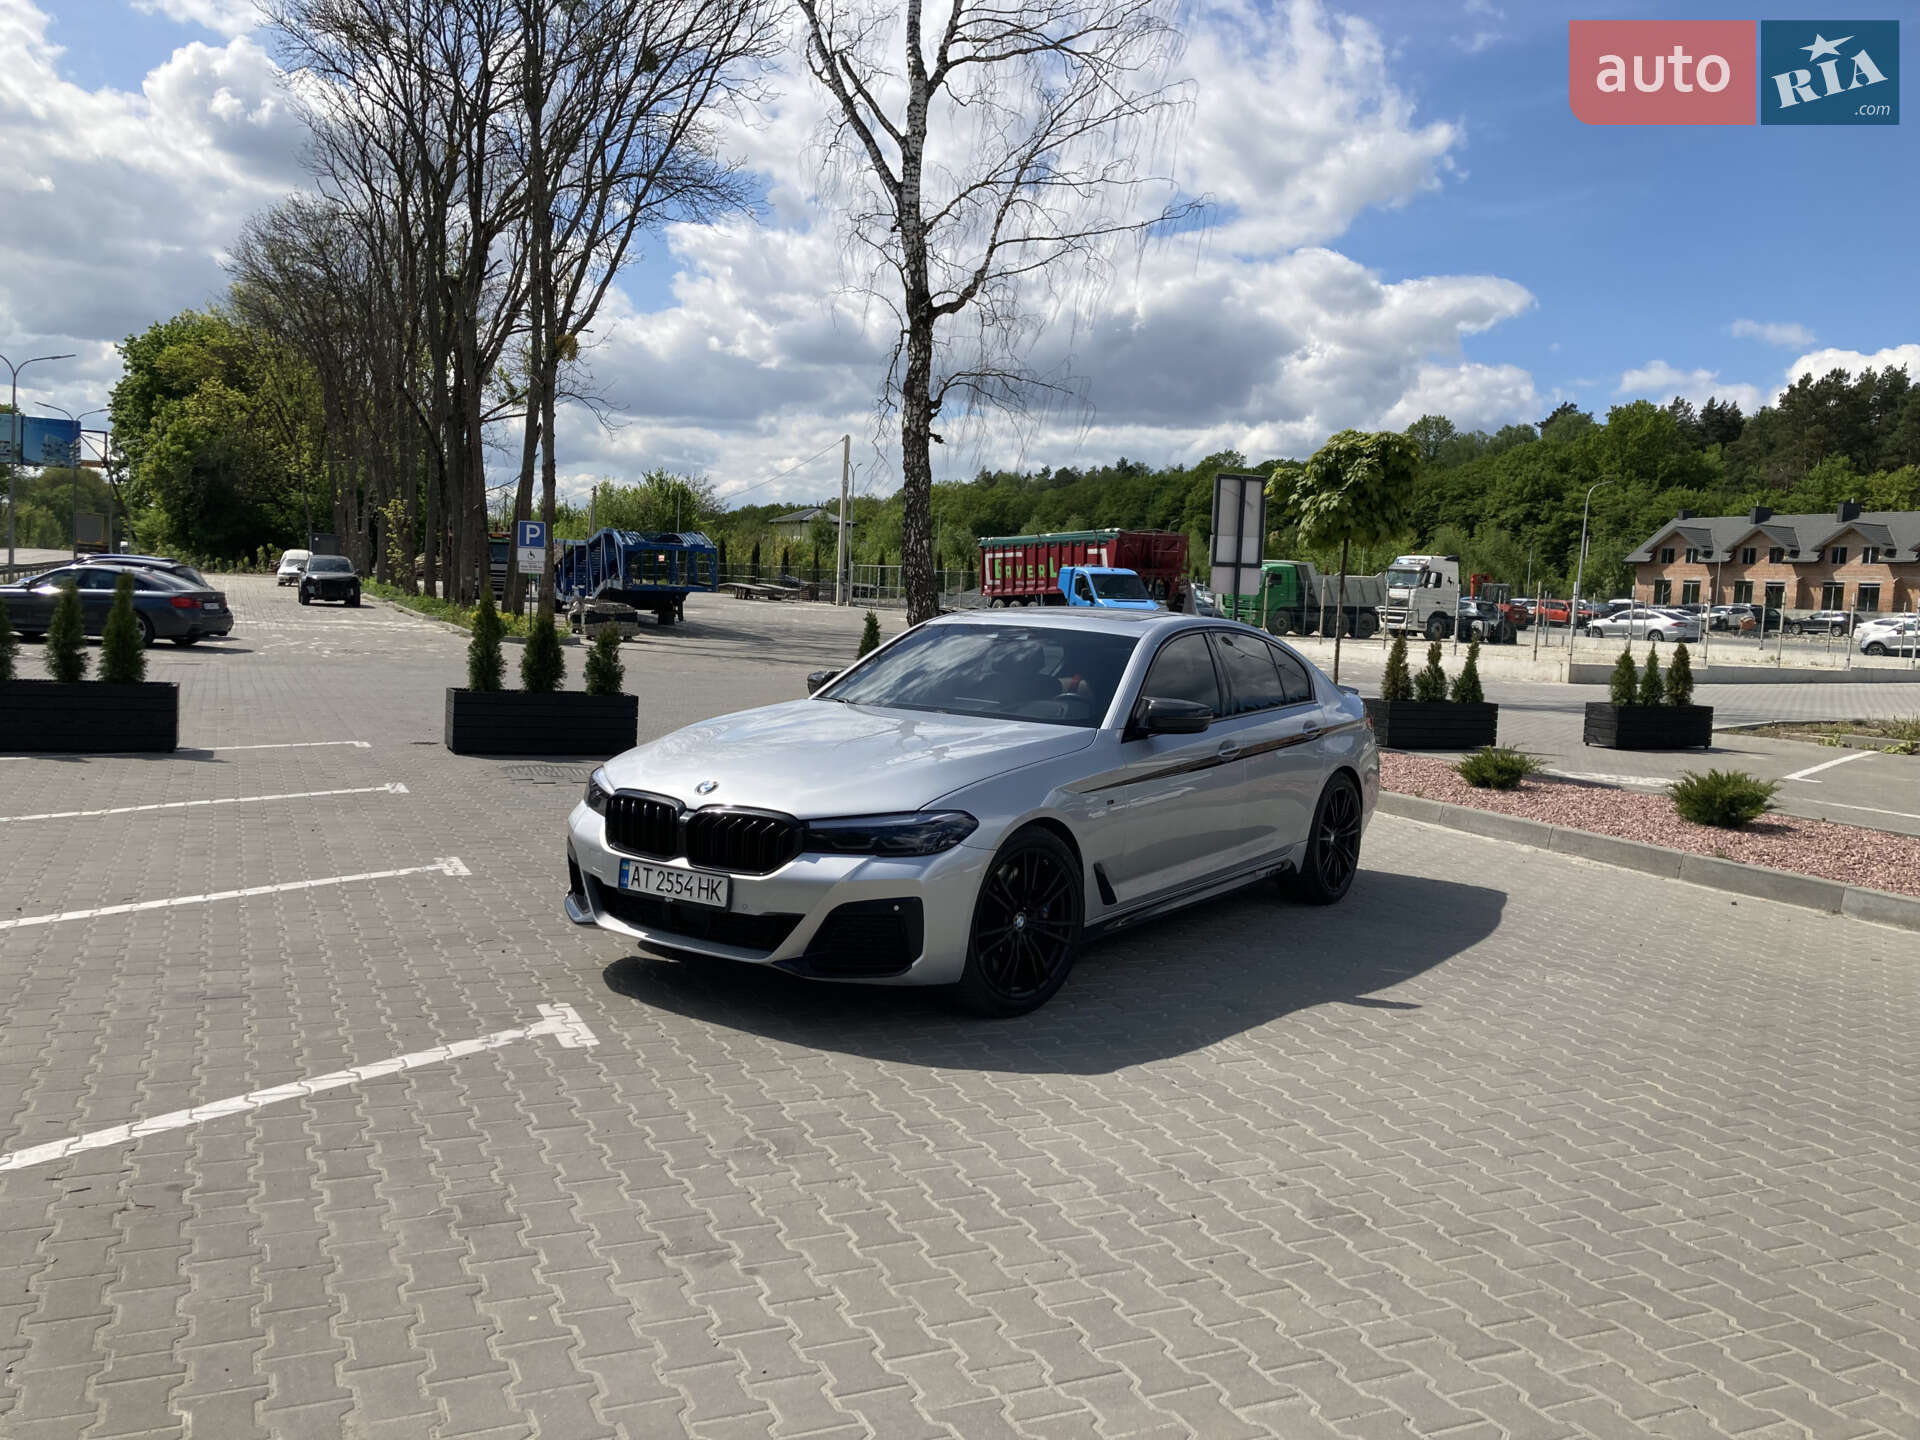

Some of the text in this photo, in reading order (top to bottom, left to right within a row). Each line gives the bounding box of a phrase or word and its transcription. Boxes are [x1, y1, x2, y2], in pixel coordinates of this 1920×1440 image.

[525, 524, 541, 545] P
[631, 865, 722, 902] AT 2554 HK
